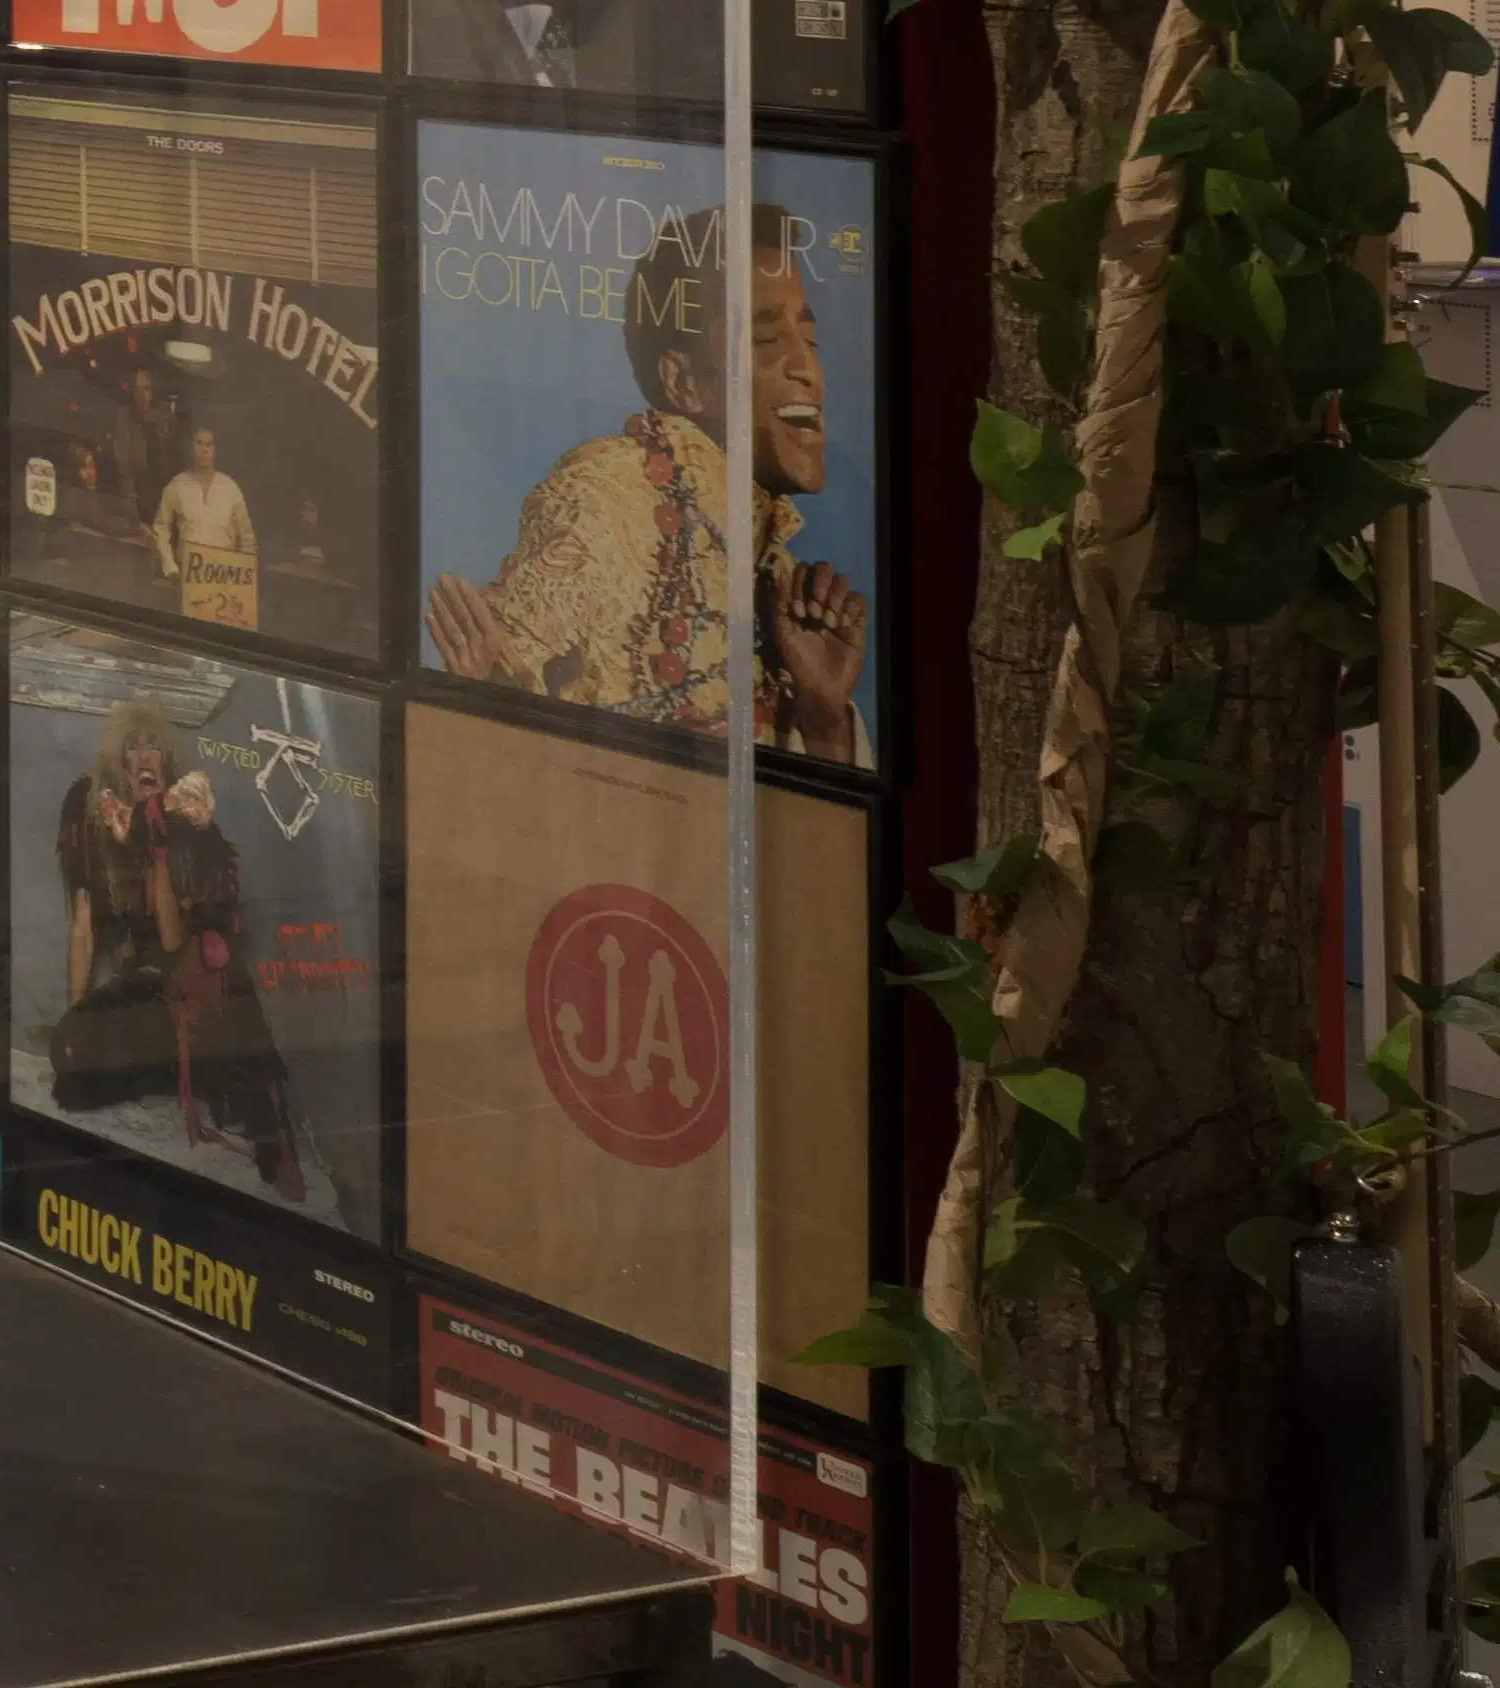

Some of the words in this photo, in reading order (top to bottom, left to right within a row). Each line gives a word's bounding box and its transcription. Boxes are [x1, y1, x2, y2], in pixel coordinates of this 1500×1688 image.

[146, 135, 173, 152] THE
[176, 137, 224, 155] DOORS
[422, 175, 607, 252] SAMMY
[759, 215, 823, 283] JR
[436, 246, 570, 317] GOTTA
[578, 264, 627, 322] BE
[636, 269, 703, 336] ME
[11, 266, 234, 377] MORRISON
[246, 276, 379, 429] HOTEL
[185, 552, 255, 585] ROOMS
[197, 736, 261, 770] TWISTED
[318, 768, 379, 805] SISTER
[557, 933, 700, 1111] JA
[38, 1188, 142, 1285] CHUCK
[152, 1233, 258, 1333] BERRY
[314, 1269, 375, 1303] STEREO
[449, 1319, 525, 1359] stereo
[433, 1388, 556, 1501] THE
[532, 1402, 609, 1449] MOTION
[618, 1433, 704, 1485] PICTURE
[736, 1583, 870, 1687] NIGHT
